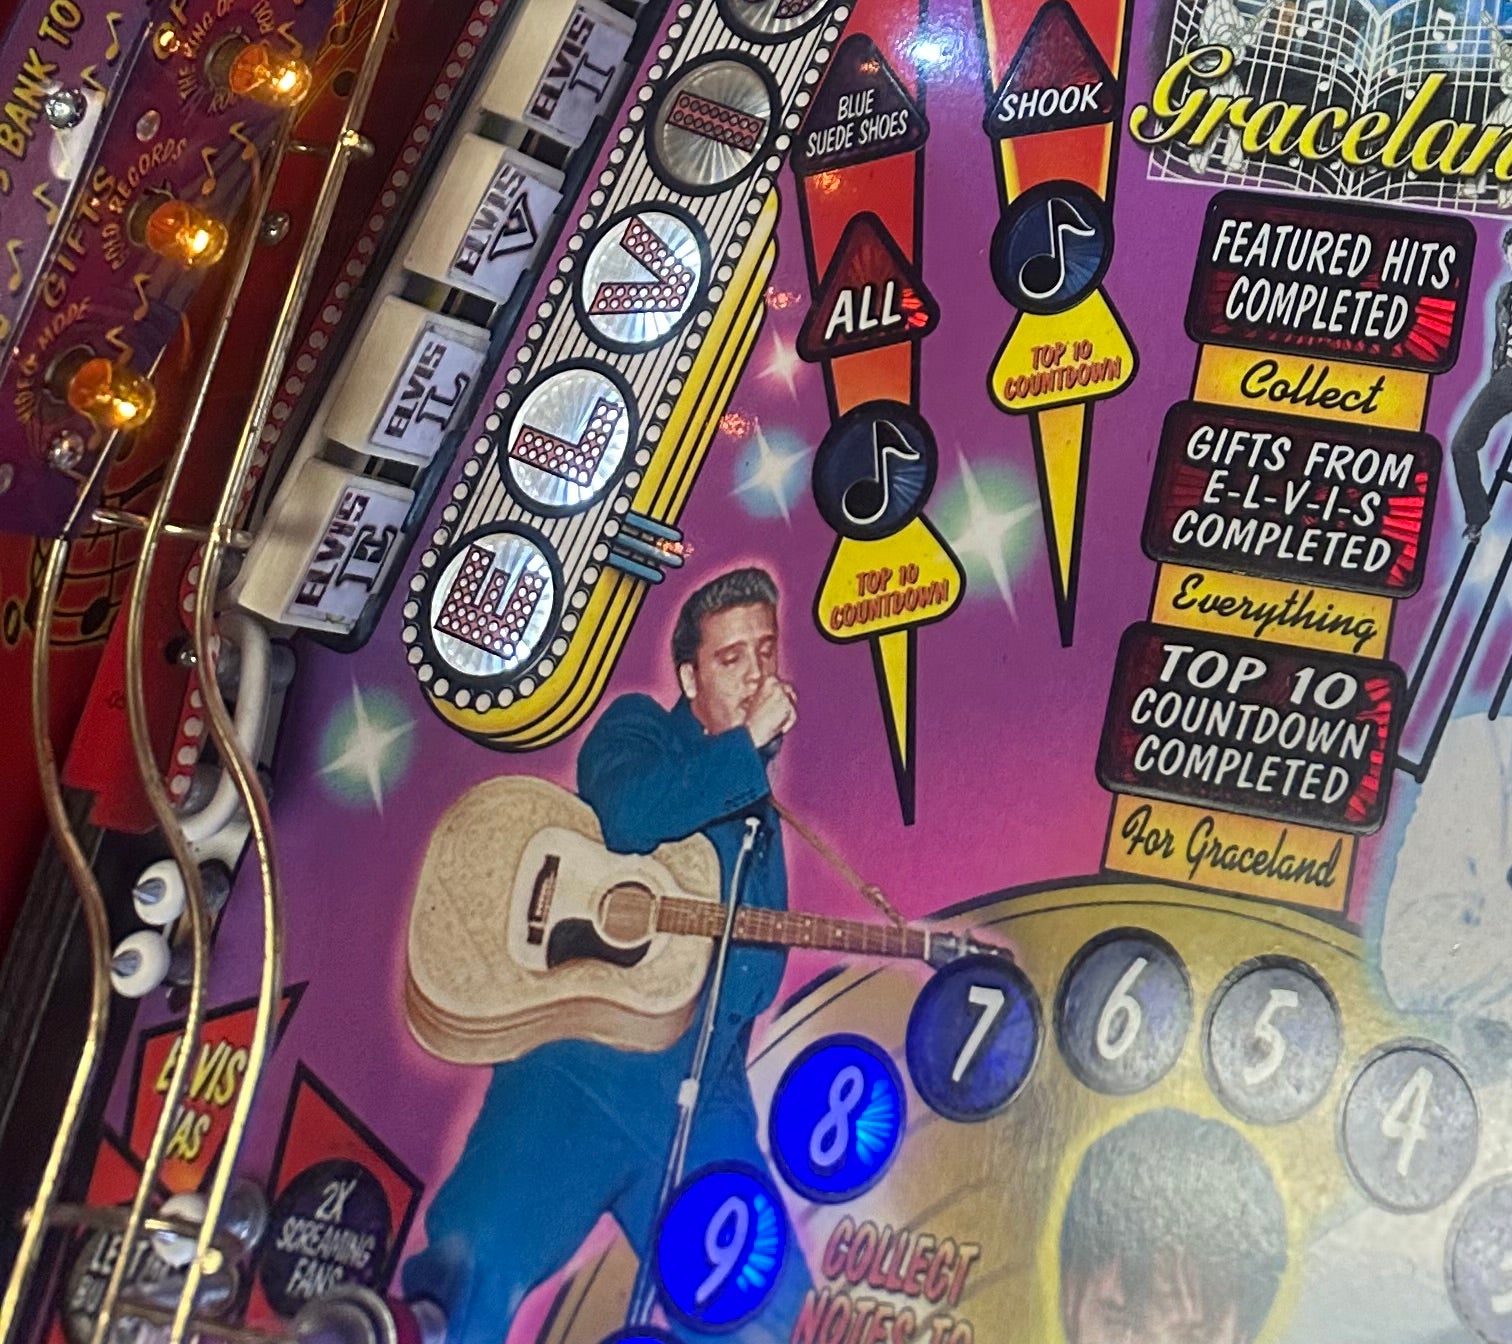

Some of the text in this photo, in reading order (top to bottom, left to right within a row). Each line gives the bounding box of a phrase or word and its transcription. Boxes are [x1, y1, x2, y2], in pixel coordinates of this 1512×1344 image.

[178, 64, 197, 100] THE
[530, 6, 595, 120] ELVIS
[0, 47, 57, 158] BANK
[806, 109, 909, 158] SUEDE SHOES
[837, 92, 875, 123] BLUE
[996, 83, 1104, 123] SHOOK
[112, 138, 188, 214] RECORDS
[41, 165, 118, 308] GIFTS
[455, 162, 526, 276] ELVIS
[488, 192, 539, 261] V
[1212, 219, 1456, 290] FEATURED HITS
[824, 281, 903, 341] ALL
[1225, 276, 1409, 340] COMPLETED
[384, 340, 446, 439] ELVIS
[1003, 355, 1122, 404] COUNTDOWN
[1030, 339, 1092, 371] TOP 10
[1240, 359, 1386, 414] Collect
[415, 372, 471, 432] L
[1187, 425, 1415, 489] GIFTS FROM
[1203, 470, 1383, 527] E-L-V-I-S
[296, 491, 370, 607] ELVIS
[335, 523, 398, 592] E
[1172, 510, 1391, 574] COMPLETED
[829, 578, 950, 631] COUNTDOWN
[855, 561, 919, 598] TOP 10
[1172, 573, 1378, 654] Everything
[1159, 645, 1358, 710] TOP 10
[1131, 688, 1371, 760] COUNTDOWN
[1134, 734, 1350, 805] COMPLETED
[1121, 804, 1344, 890] For Graceland
[952, 985, 1006, 1083] 7
[1096, 958, 1149, 1060] 6
[1244, 988, 1299, 1087] 5
[809, 1065, 865, 1167] 8
[1381, 1066, 1434, 1177] 4
[276, 1216, 377, 1268] SCREAMING
[695, 1195, 749, 1306] 9
[821, 1215, 981, 1307] COLLECT
